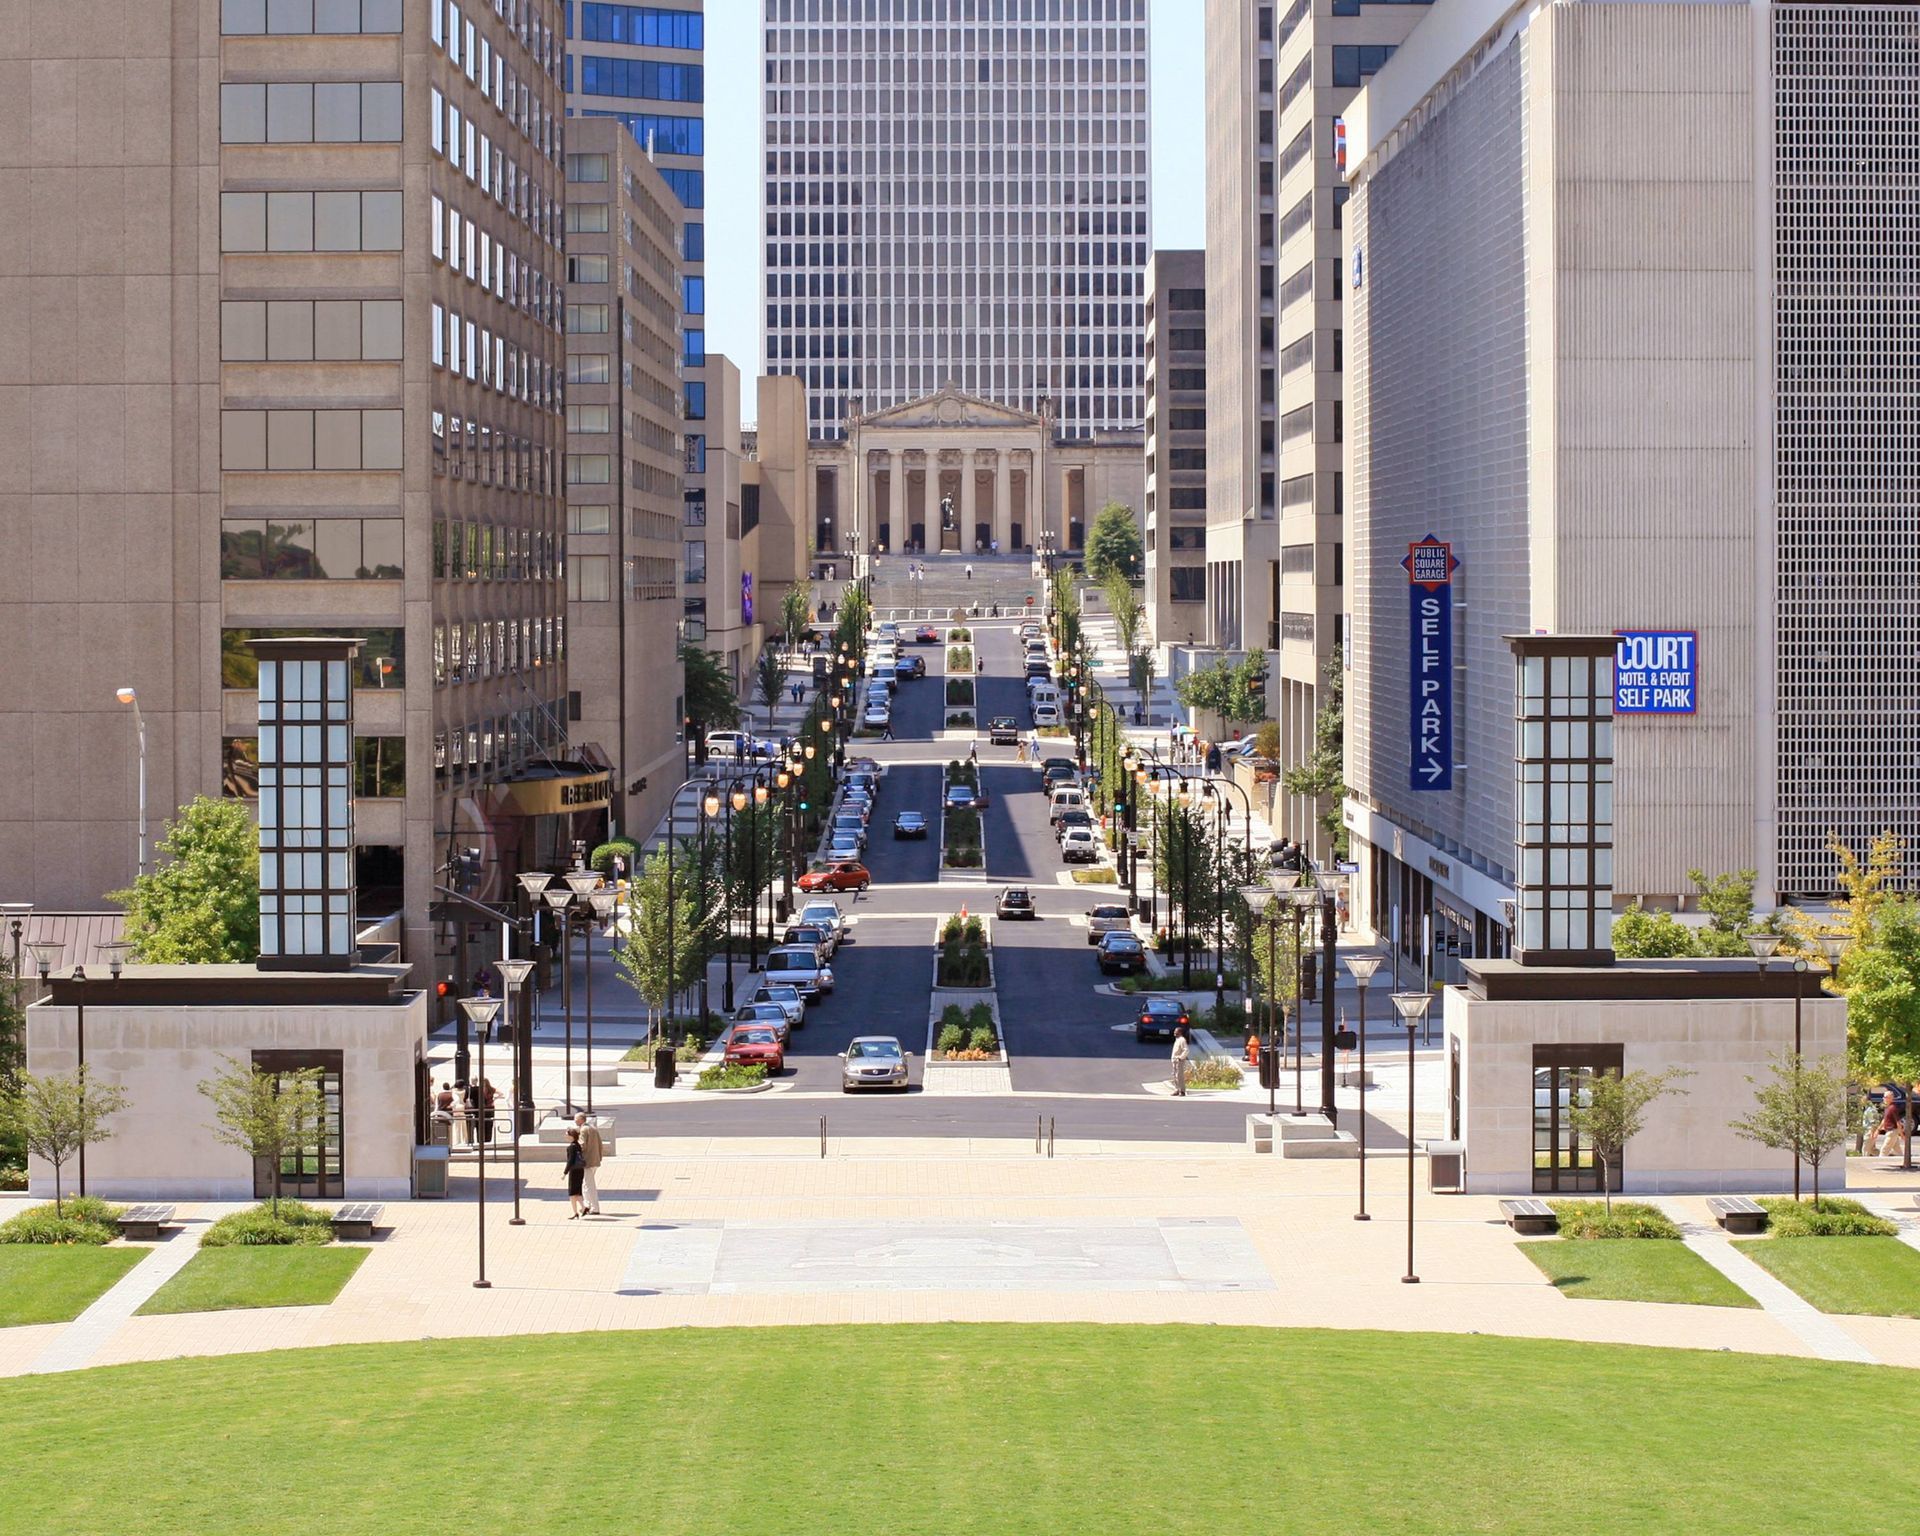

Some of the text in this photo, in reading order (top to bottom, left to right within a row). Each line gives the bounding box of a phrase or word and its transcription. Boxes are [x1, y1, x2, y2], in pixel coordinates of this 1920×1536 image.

[1415, 548, 1445, 558] PUBLIC
[1415, 559, 1445, 569] SQUARE
[1415, 569, 1446, 579] GARAGE
[1617, 636, 1693, 670] COURT
[1421, 598, 1441, 753] SELF PARK
[1619, 672, 1690, 686] HOTEL & EVENT
[1618, 688, 1691, 708] SELF PARK
